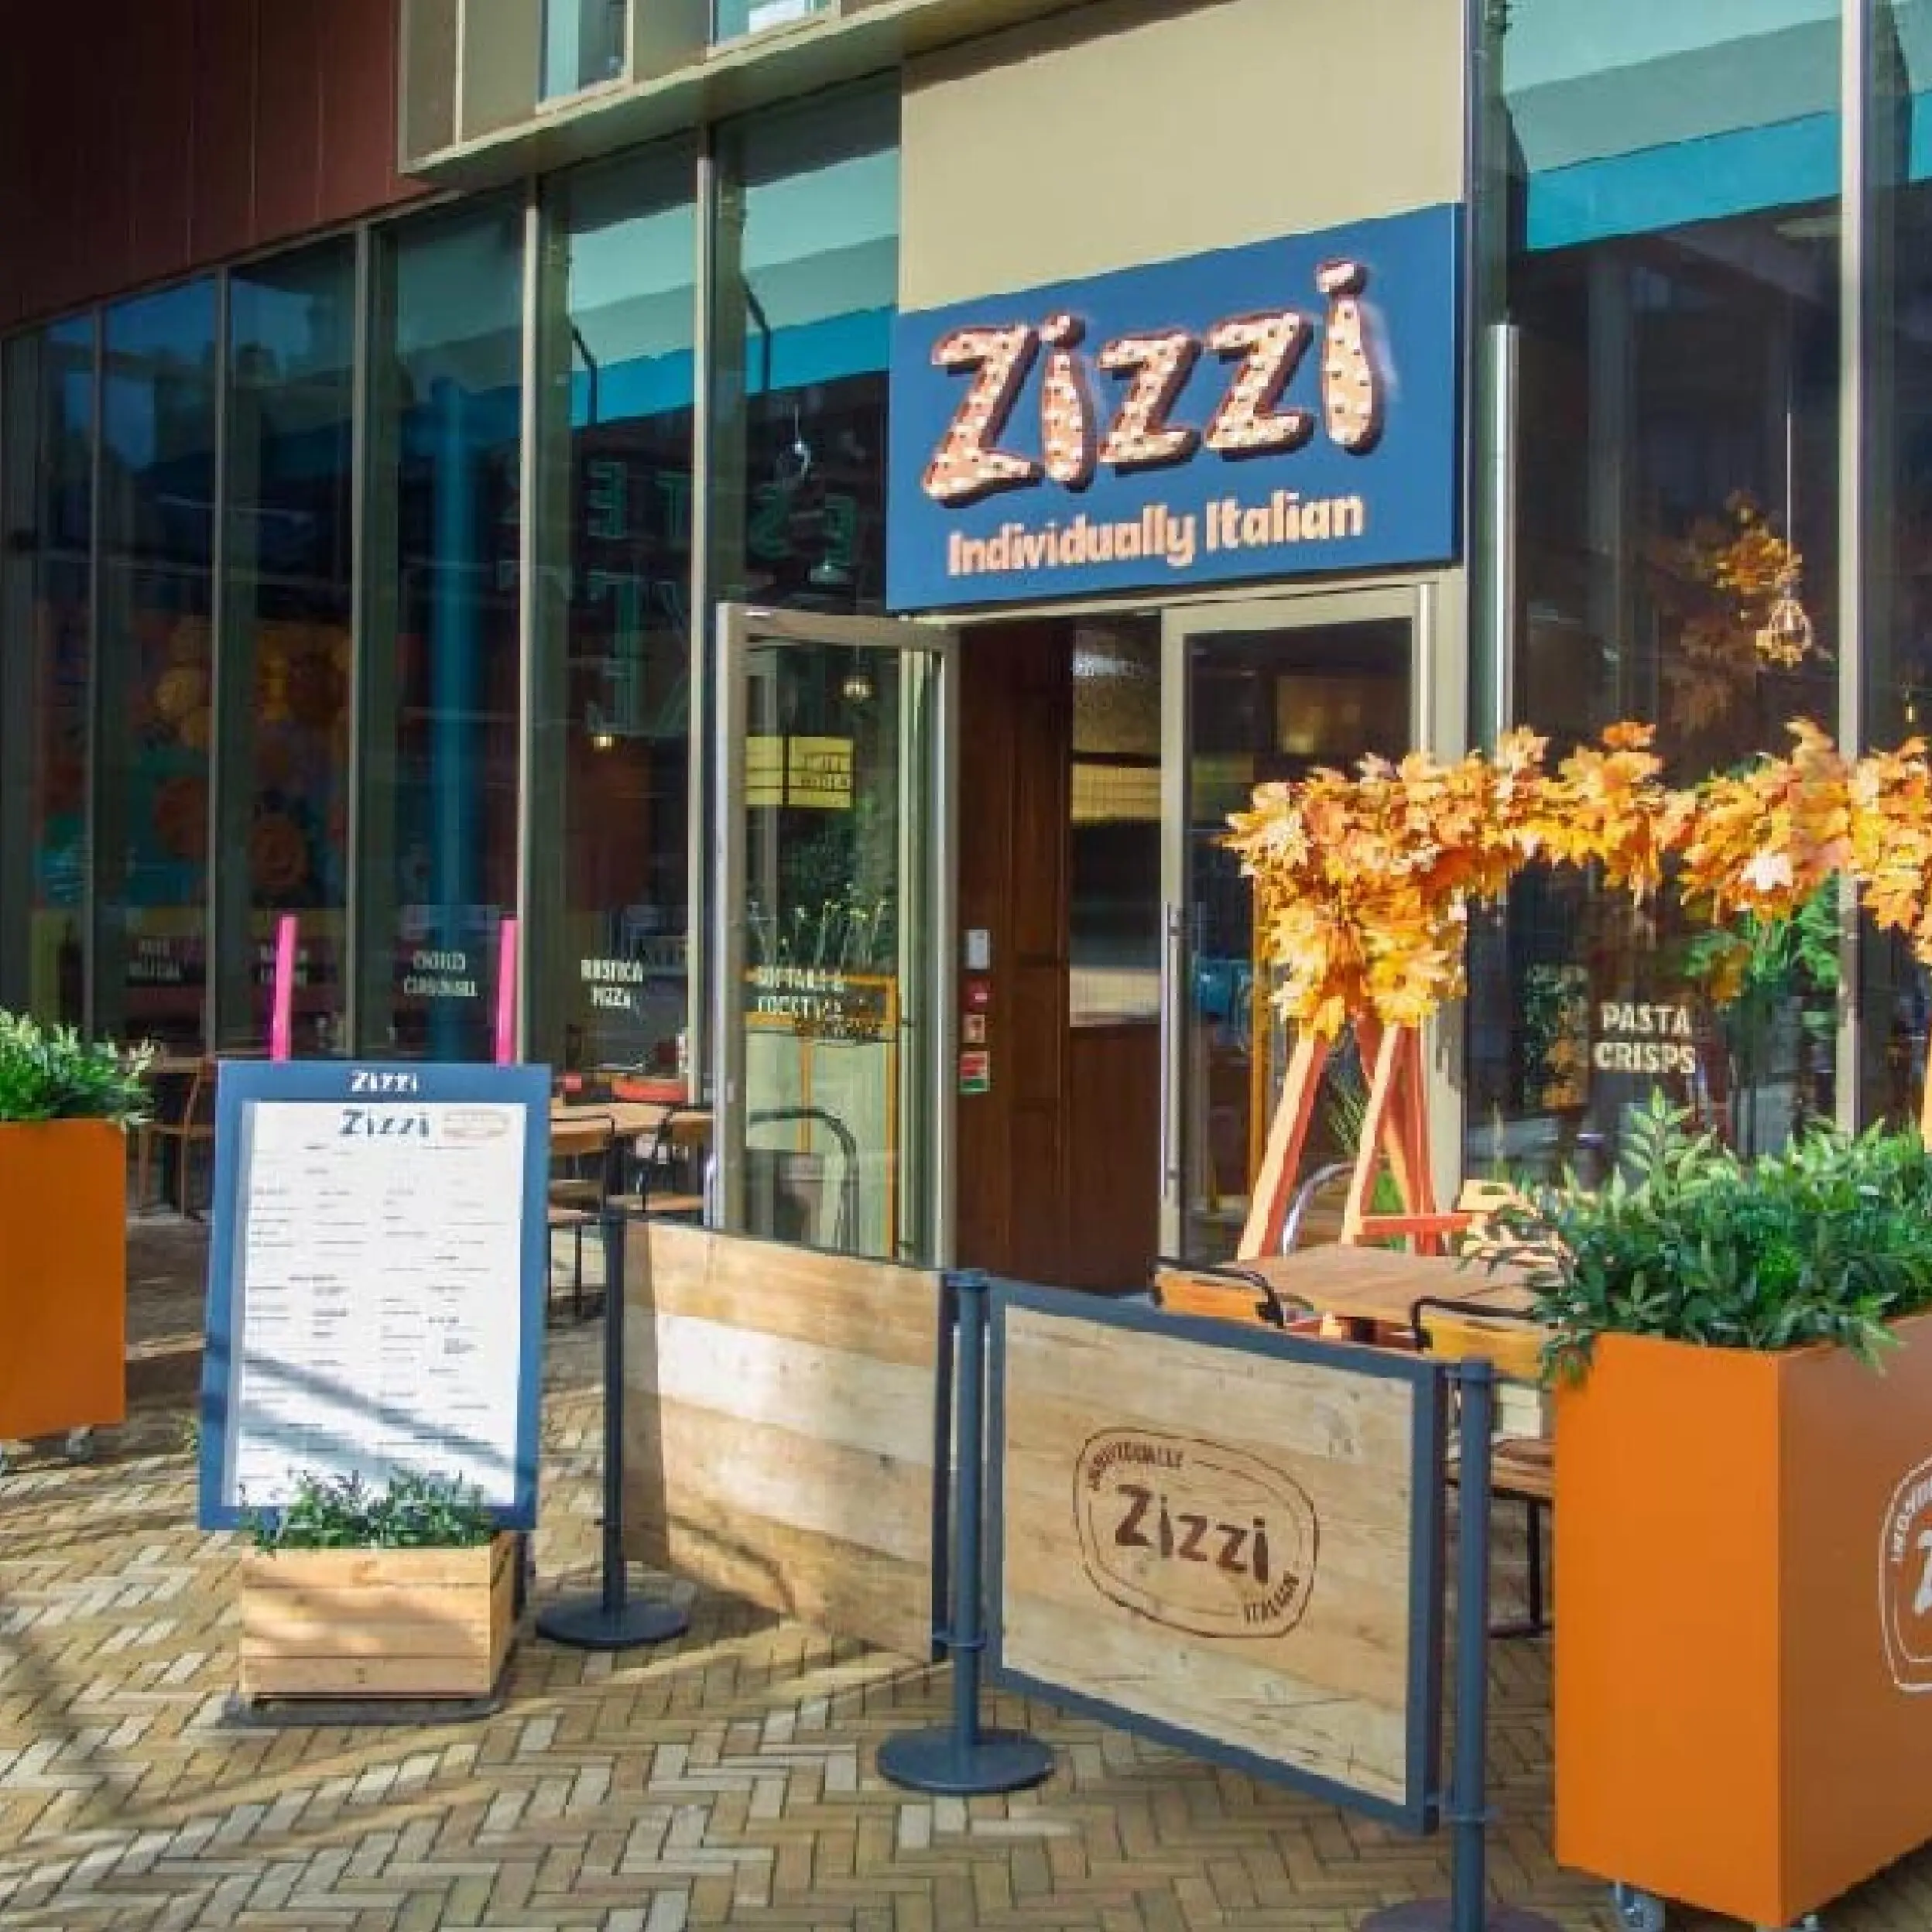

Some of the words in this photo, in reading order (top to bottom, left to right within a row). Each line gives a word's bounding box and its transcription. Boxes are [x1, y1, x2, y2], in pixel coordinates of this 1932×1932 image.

[921, 259, 1384, 508] Zizzi
[947, 502, 1196, 577] Individually
[1205, 490, 1365, 551] Italian
[1593, 1042, 1696, 1074] CRISPS
[1601, 1002, 1693, 1037] PASTA
[1114, 1483, 1269, 1586] Zizzi
